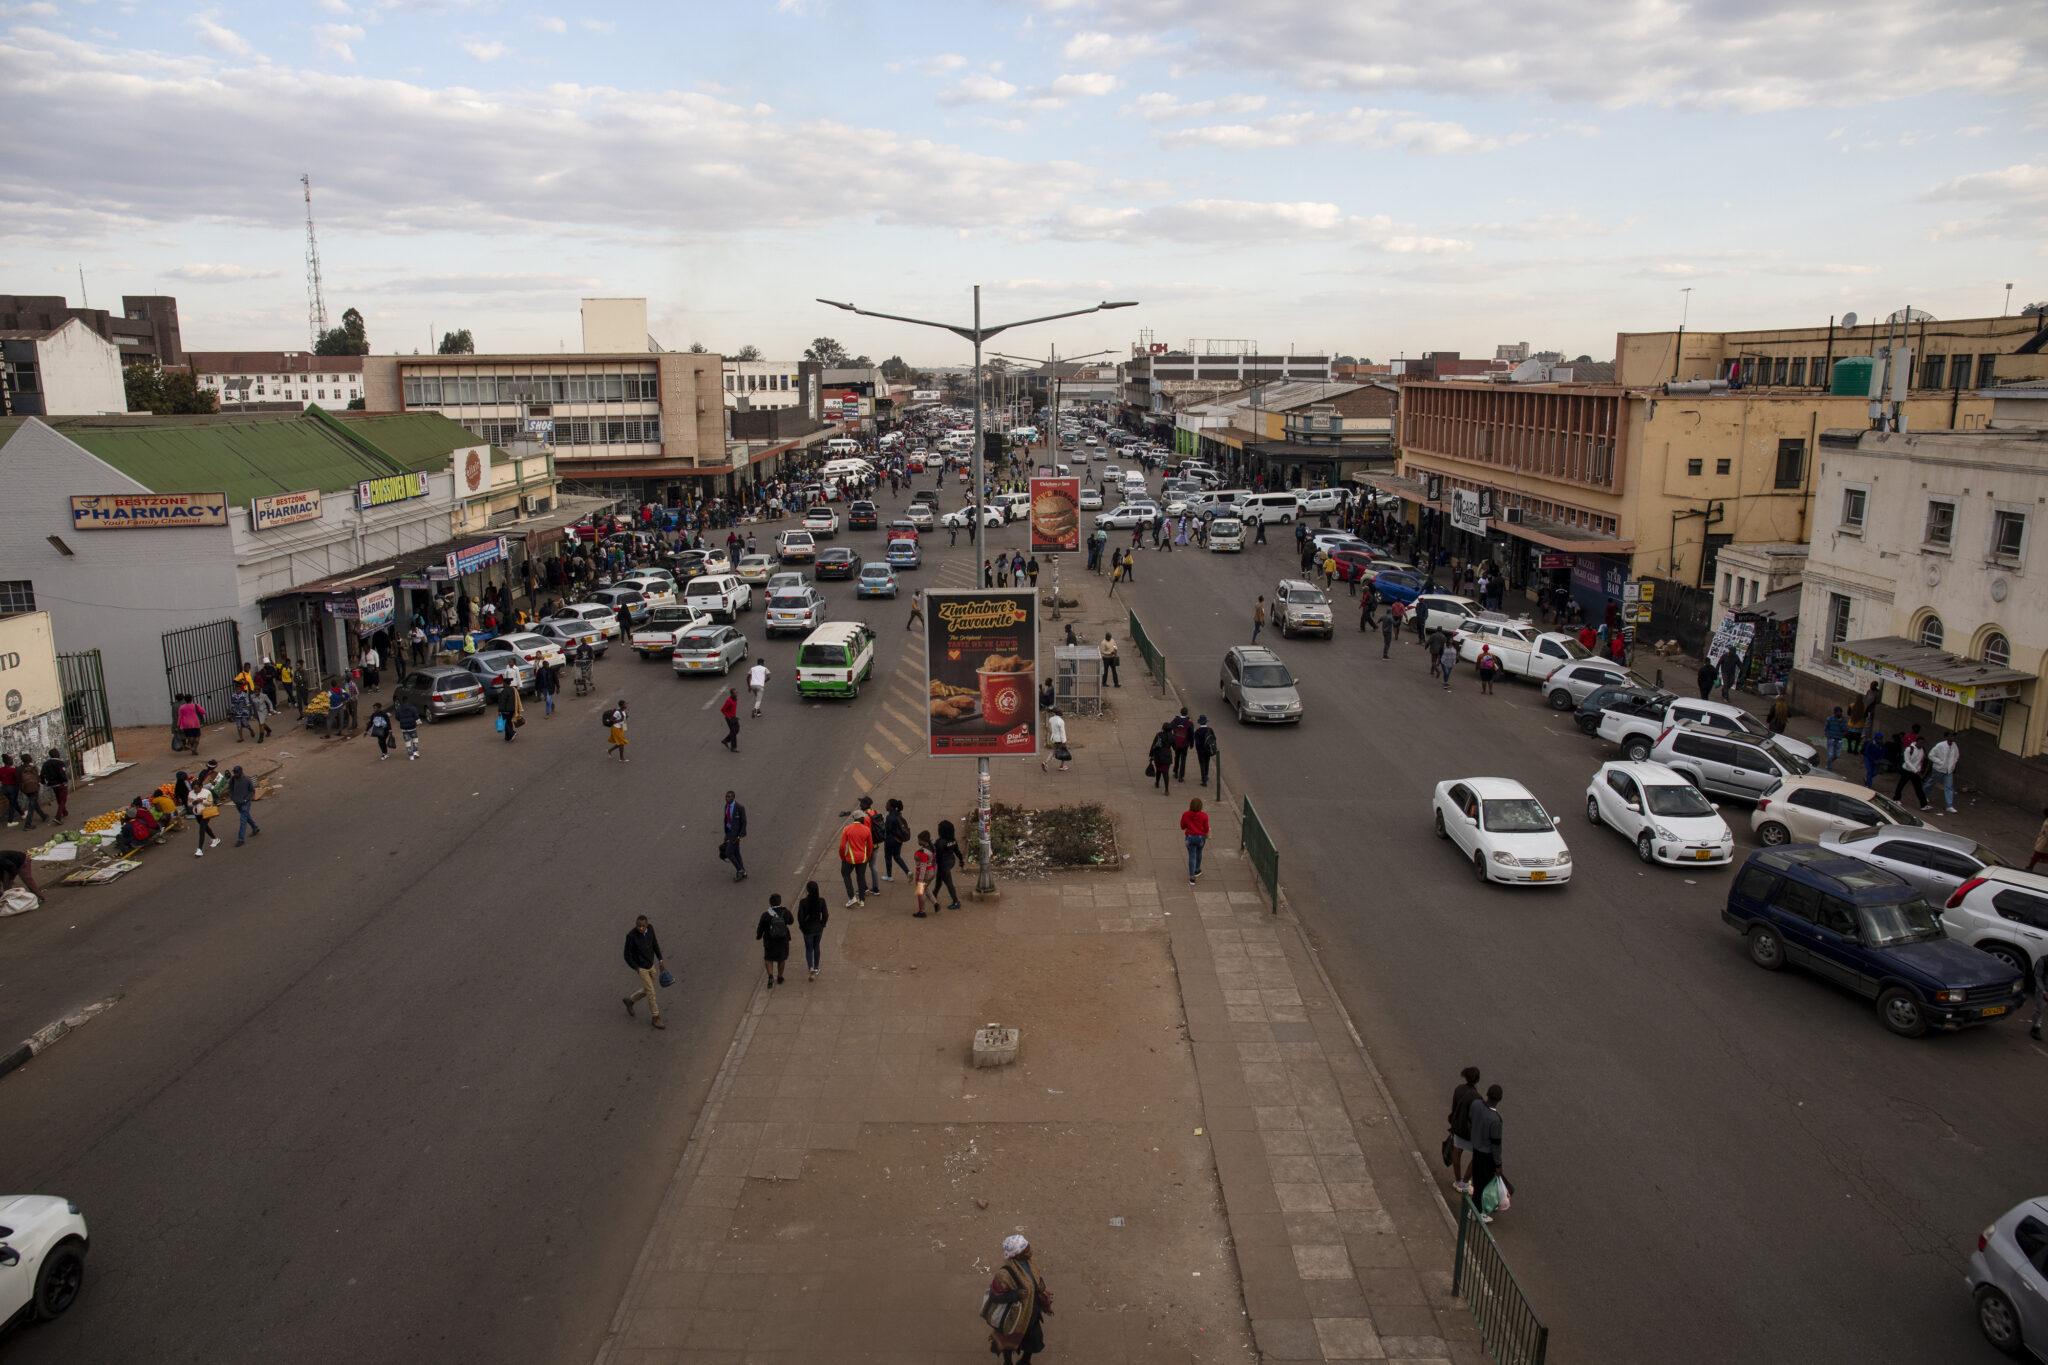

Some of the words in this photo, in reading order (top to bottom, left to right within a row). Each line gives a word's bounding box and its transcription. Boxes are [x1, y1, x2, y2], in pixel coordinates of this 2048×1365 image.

[1150, 343, 1168, 353] OK
[529, 420, 553, 431] SHOE
[370, 475, 406, 505] CROSSOVER
[404, 472, 421, 498] MALL
[115, 498, 188, 507] BESTZONE
[276, 495, 307, 506] BESTZONE
[75, 506, 223, 520] PHARMACY
[259, 500, 319, 520] PHARMACY
[1606, 570, 1622, 585] STAR
[1607, 582, 1620, 595] BAR
[360, 597, 393, 618] PHARMACY
[940, 601, 1016, 618] Zimbabwe's
[949, 613, 1013, 631] Favourite
[1914, 678, 1929, 691] MORE
[1931, 684, 1943, 695] FOR
[1943, 688, 1956, 698] LESS
